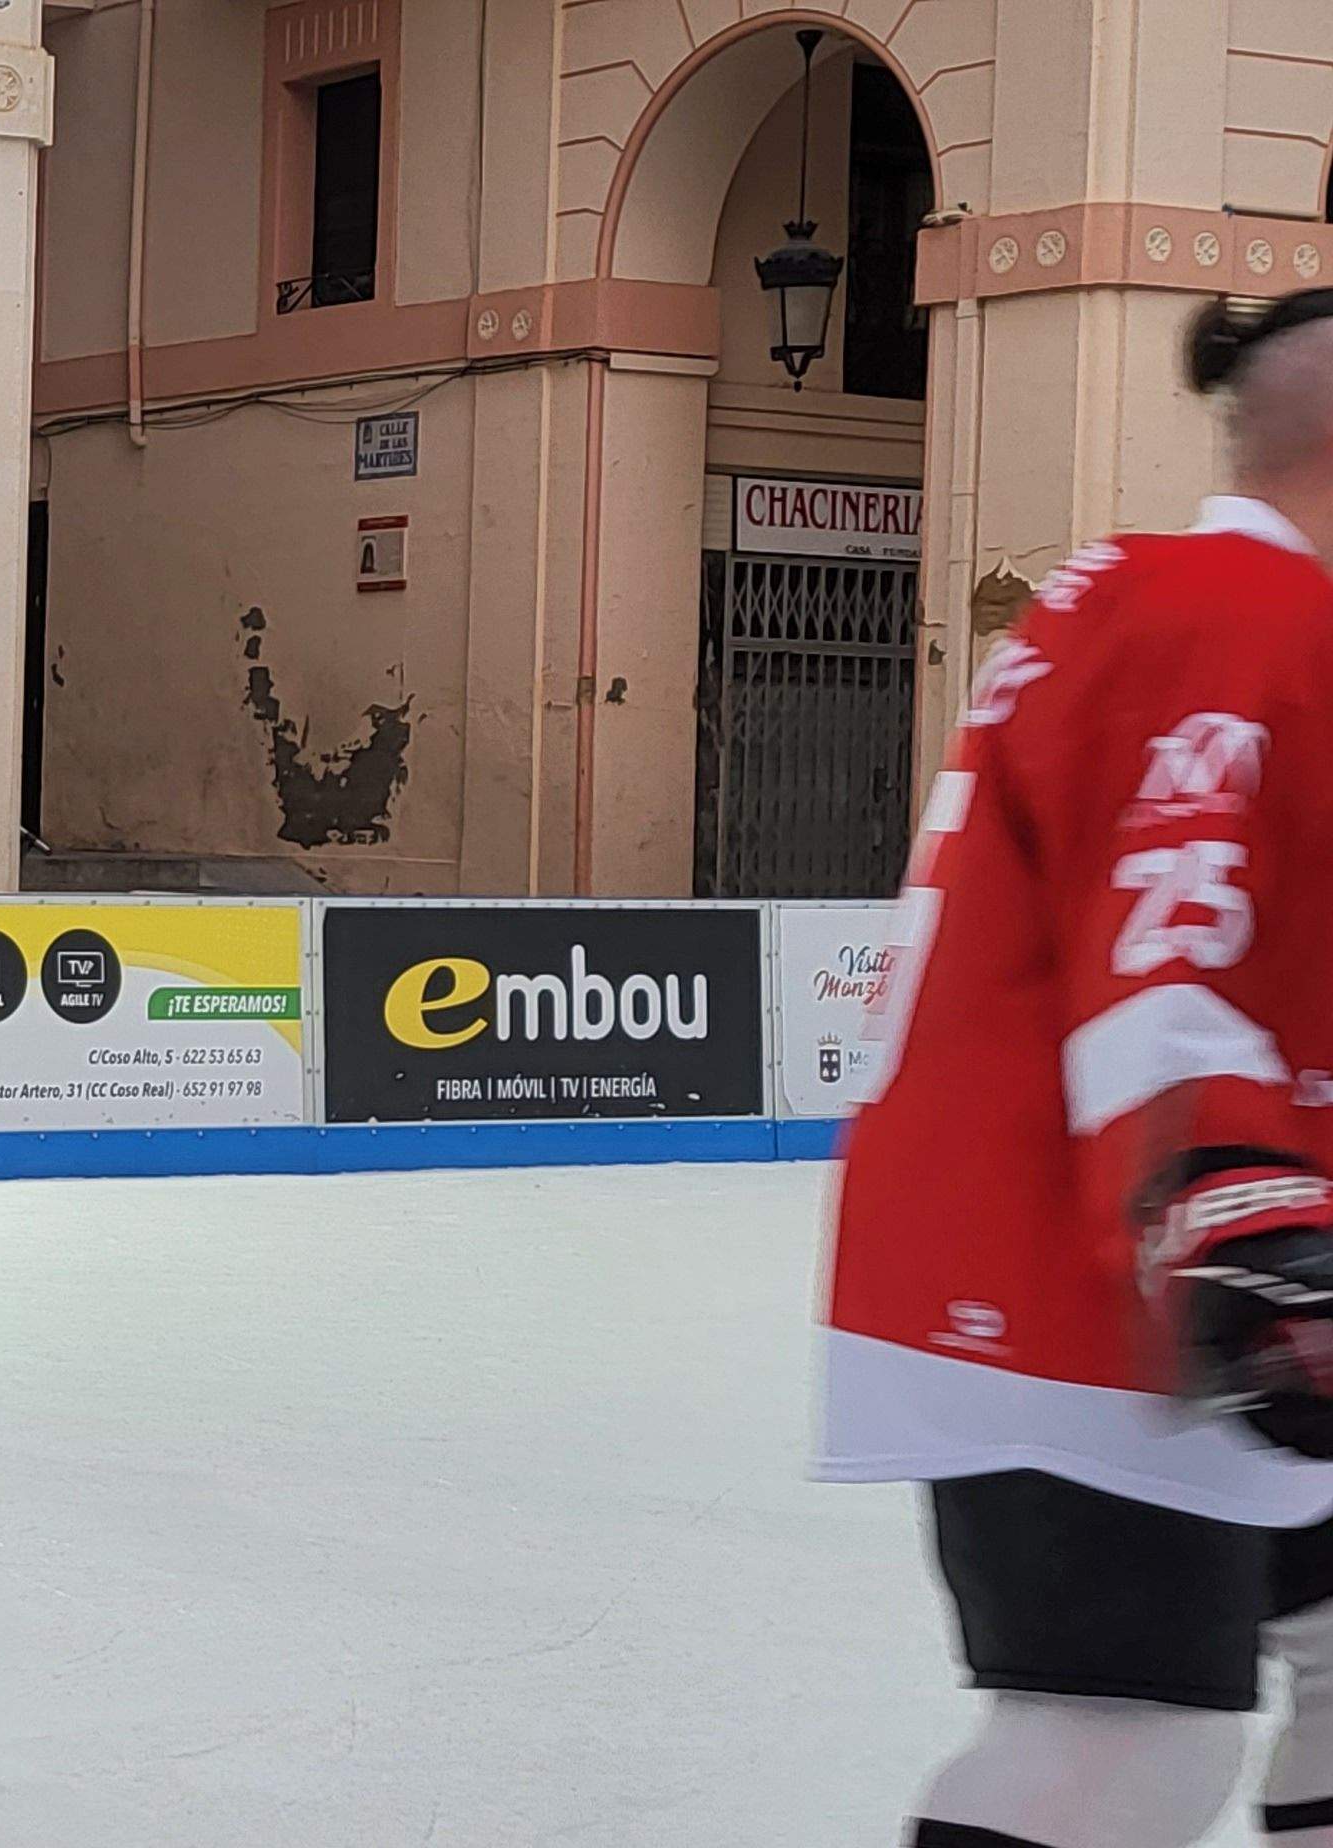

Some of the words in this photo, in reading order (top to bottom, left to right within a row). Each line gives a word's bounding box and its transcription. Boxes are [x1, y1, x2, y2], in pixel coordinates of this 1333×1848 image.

[379, 421, 408, 437] CALLE
[379, 439, 390, 450] DE
[392, 437, 408, 449] LAS
[61, 994, 89, 1007] AGILE
[91, 994, 104, 1006] TV
[384, 944, 708, 1049] embou
[168, 996, 191, 1017] ¡TE
[193, 995, 287, 1013] ESPERAMOS!
[88, 1050, 130, 1064] C/Coso
[133, 1048, 161, 1066] Alto,
[165, 1050, 174, 1063] 5
[183, 1049, 206, 1063] 622
[209, 1049, 225, 1063] 53
[227, 1049, 243, 1063] 65
[245, 1049, 261, 1063] 63
[20, 1083, 63, 1100] Artero,
[67, 1083, 82, 1097] 31
[85, 1082, 107, 1100] (CC
[110, 1083, 139, 1098] Coso
[142, 1081, 174, 1099] Real)
[183, 1081, 206, 1096] 652
[209, 1081, 224, 1096] 91
[227, 1081, 242, 1096] 97
[246, 1081, 262, 1096] 98
[436, 1079, 482, 1100] FIBRA
[497, 1073, 546, 1100] MÓVIL
[560, 1077, 580, 1098] TV
[591, 1072, 657, 1098] ENERGÍA
